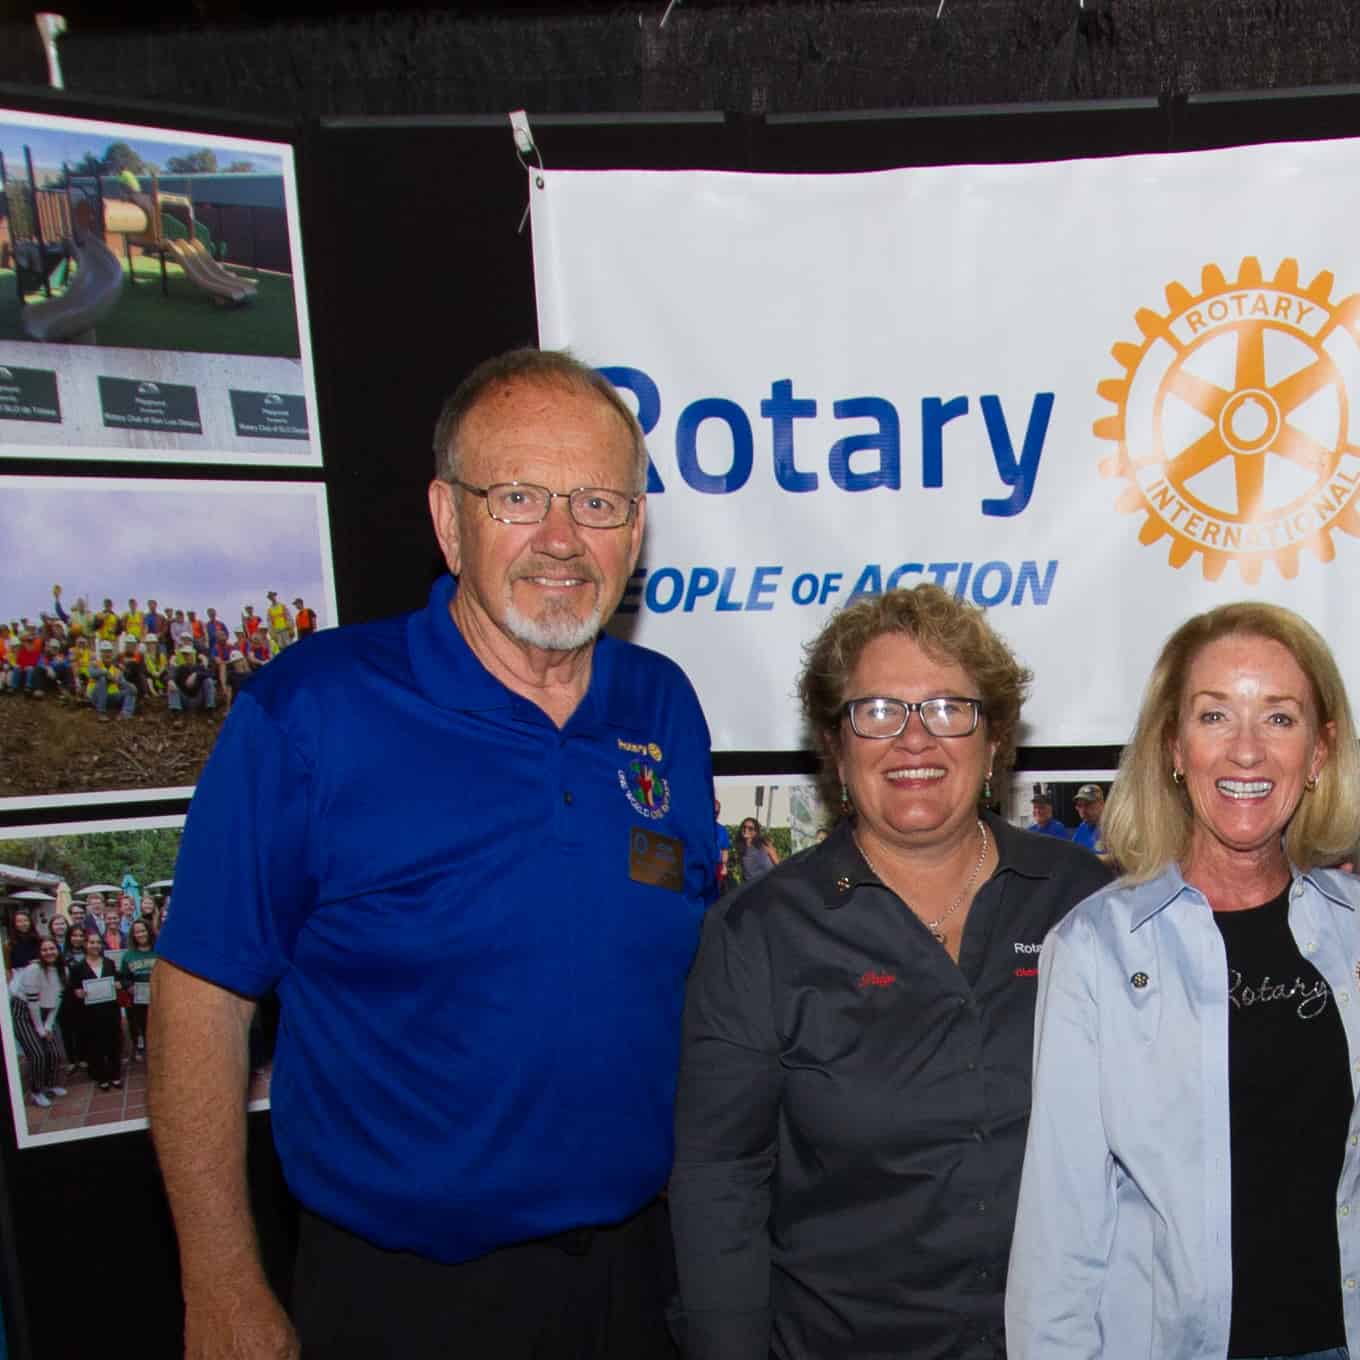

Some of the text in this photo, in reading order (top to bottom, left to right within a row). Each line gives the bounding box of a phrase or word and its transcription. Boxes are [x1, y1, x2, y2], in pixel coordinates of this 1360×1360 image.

[1185, 292, 1314, 334] ROTARY
[615, 566, 783, 613] EOPLE
[791, 572, 843, 605] OF
[1014, 942, 1042, 955] Rota
[1229, 968, 1329, 1019] Rotary
